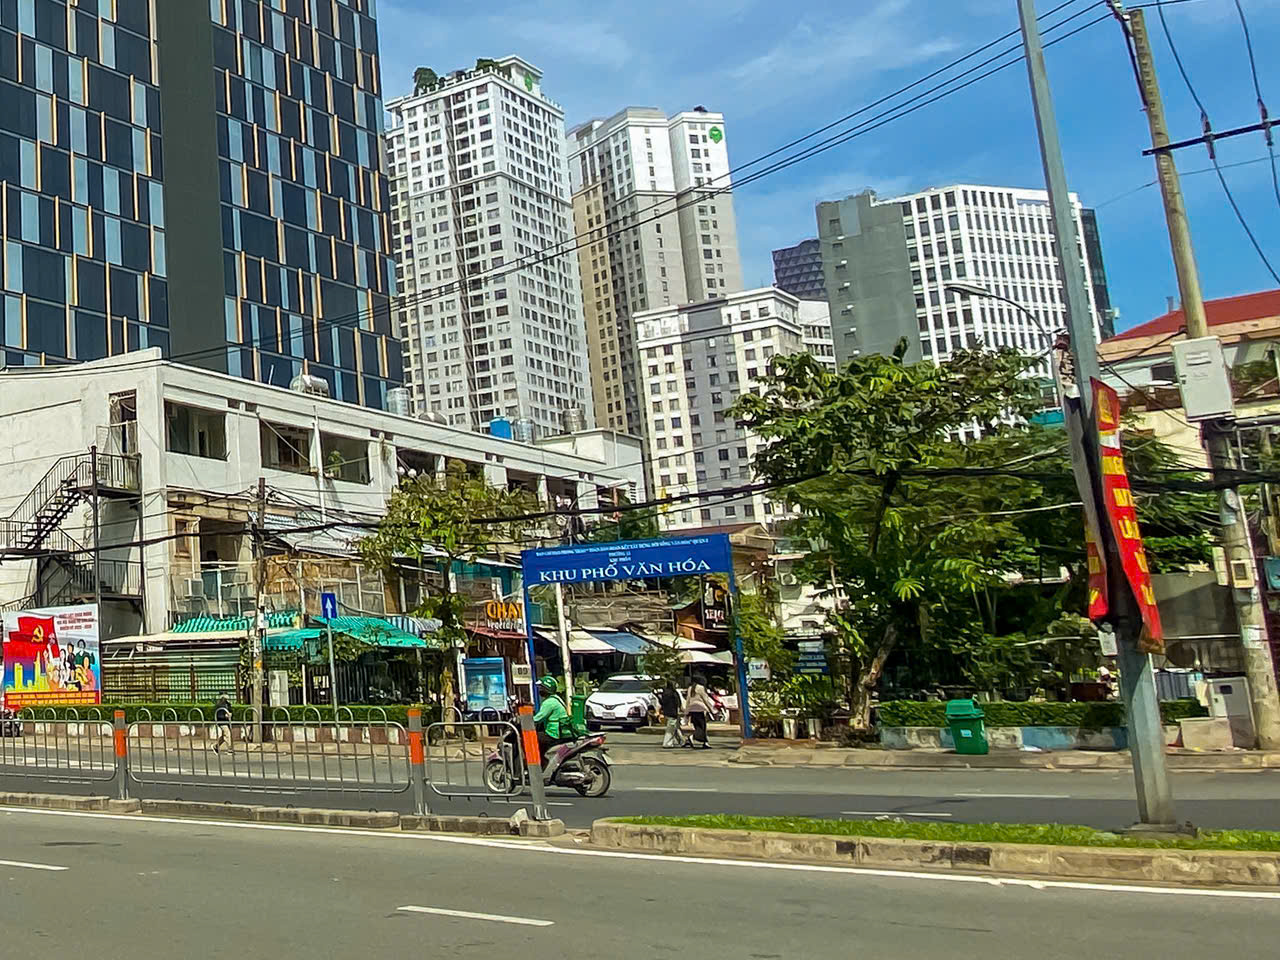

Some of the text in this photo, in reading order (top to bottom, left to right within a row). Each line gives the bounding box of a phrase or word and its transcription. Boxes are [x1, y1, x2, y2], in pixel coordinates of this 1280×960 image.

[540, 558, 711, 582] KHU PHỐ VĂN HÓA
